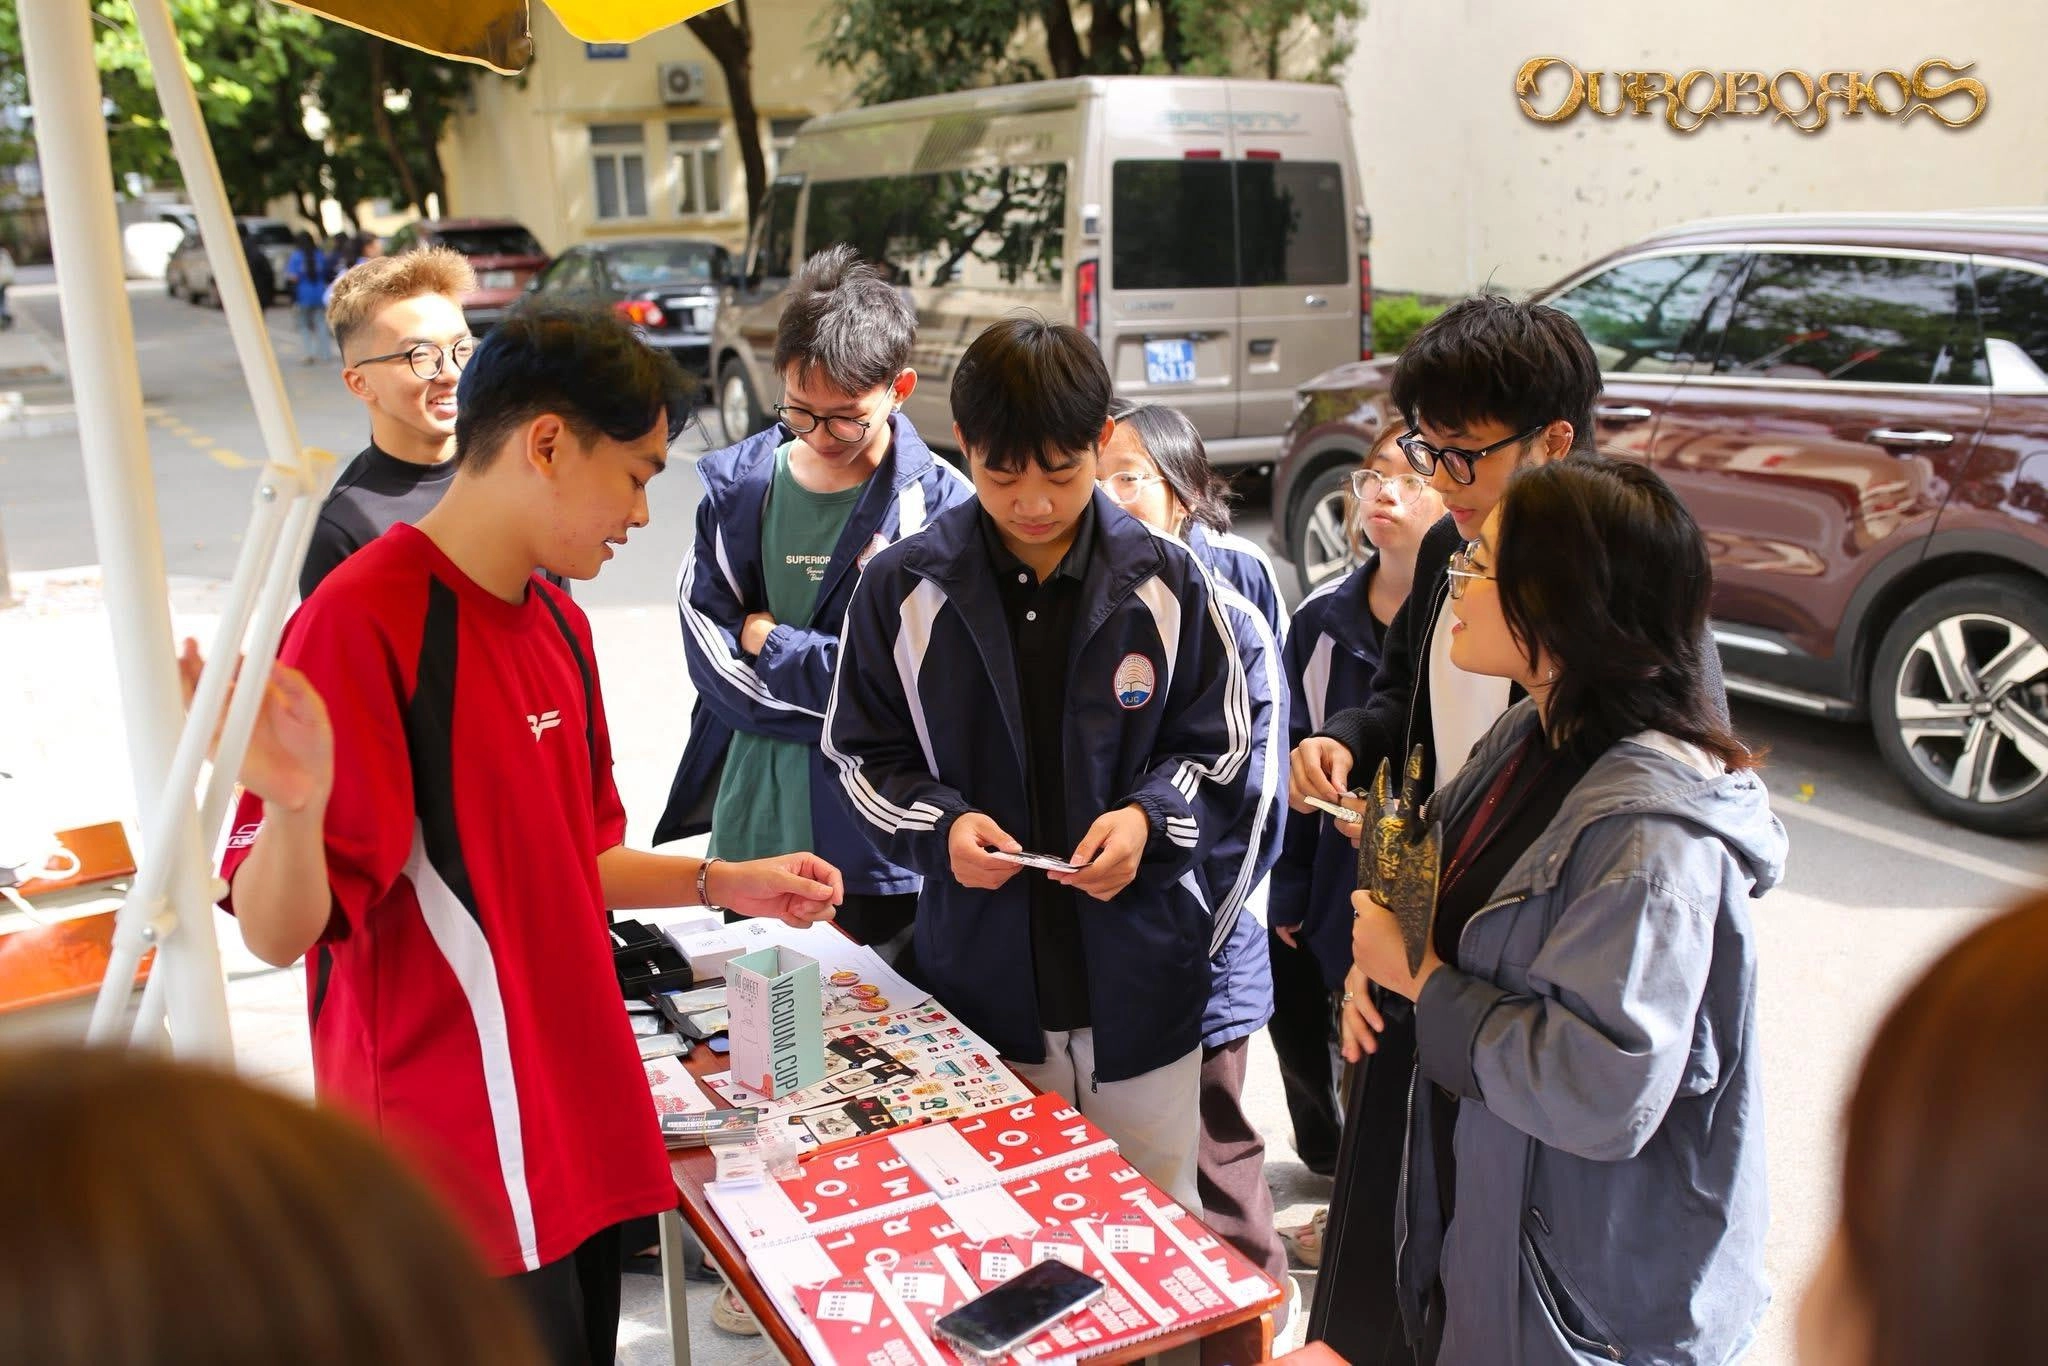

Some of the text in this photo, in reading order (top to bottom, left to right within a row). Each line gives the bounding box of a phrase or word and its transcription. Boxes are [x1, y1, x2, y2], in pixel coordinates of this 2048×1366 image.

[1125, 696, 1140, 704] AJC
[771, 976, 795, 1054] VACUUM
[774, 1055, 799, 1090] CUP
